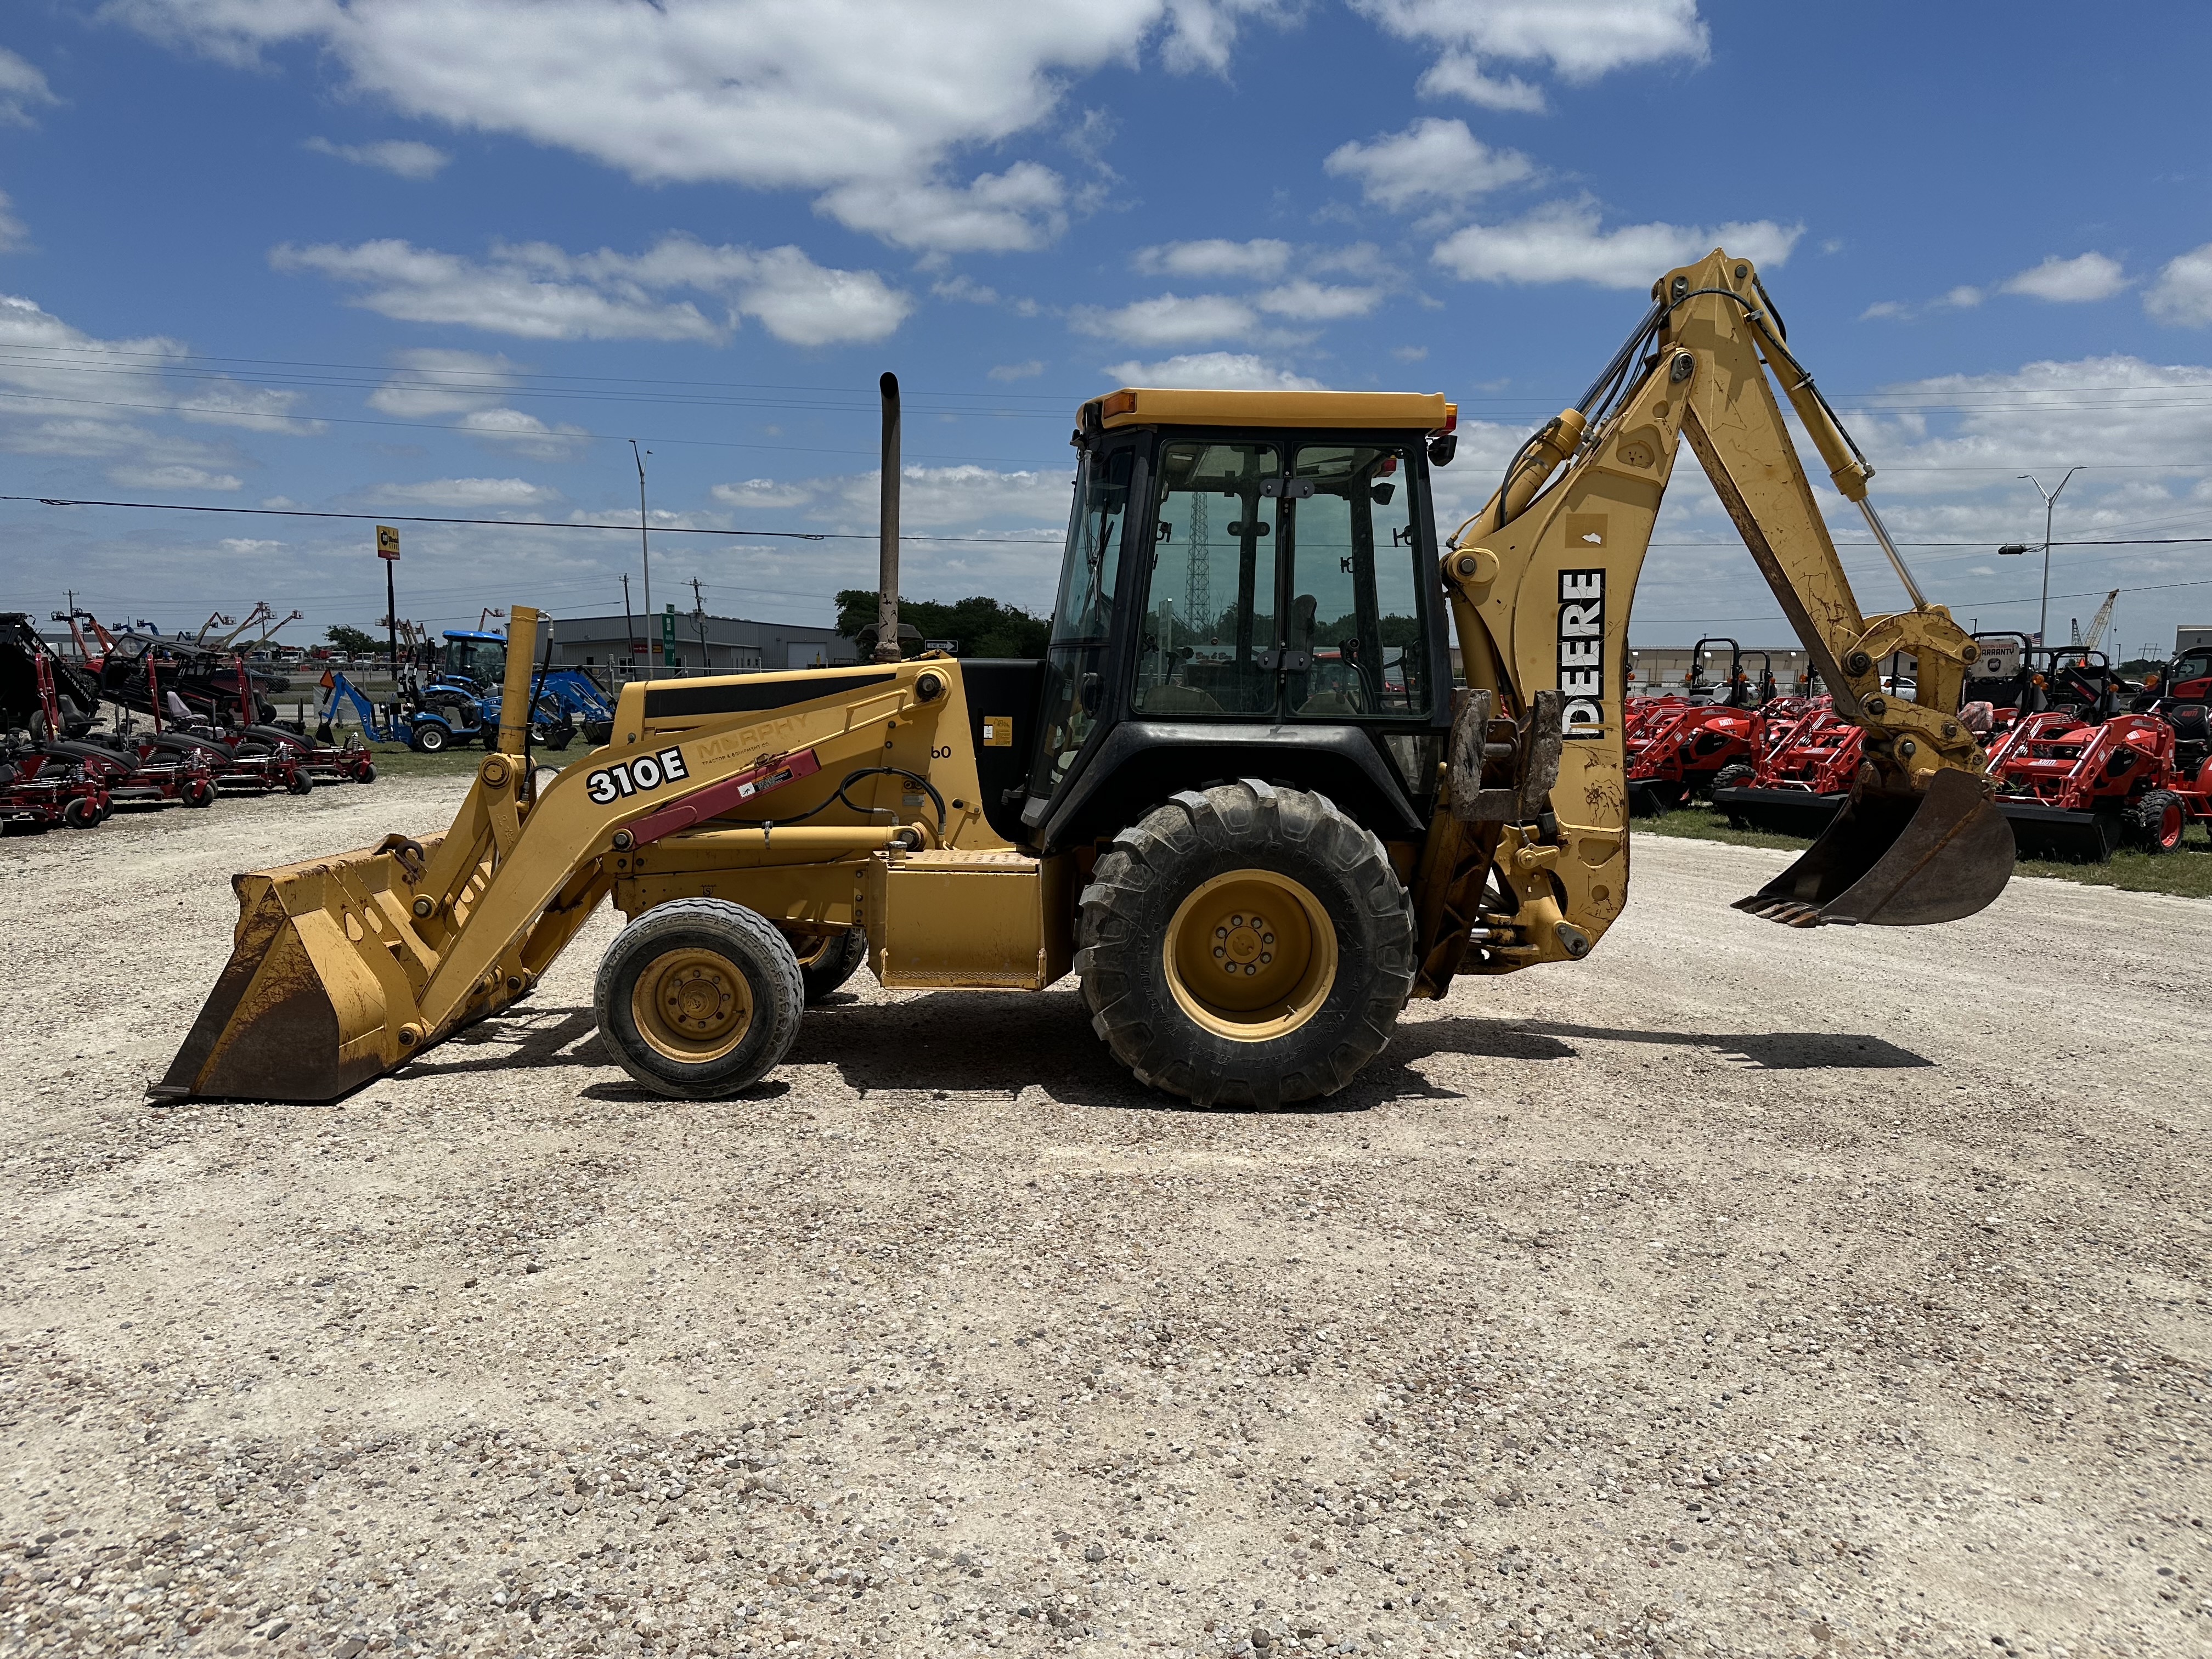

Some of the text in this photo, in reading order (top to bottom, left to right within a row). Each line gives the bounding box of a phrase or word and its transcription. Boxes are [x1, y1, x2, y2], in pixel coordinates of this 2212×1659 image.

[1561, 573, 1601, 735] DEERE
[696, 713, 809, 759] MURPHY
[702, 755, 726, 765] TRACTOR
[732, 745, 760, 757] EQUIPMENT
[586, 746, 690, 805] 310E
[1139, 964, 1340, 1069] INDUSTRIAL REAR TRACTOR
